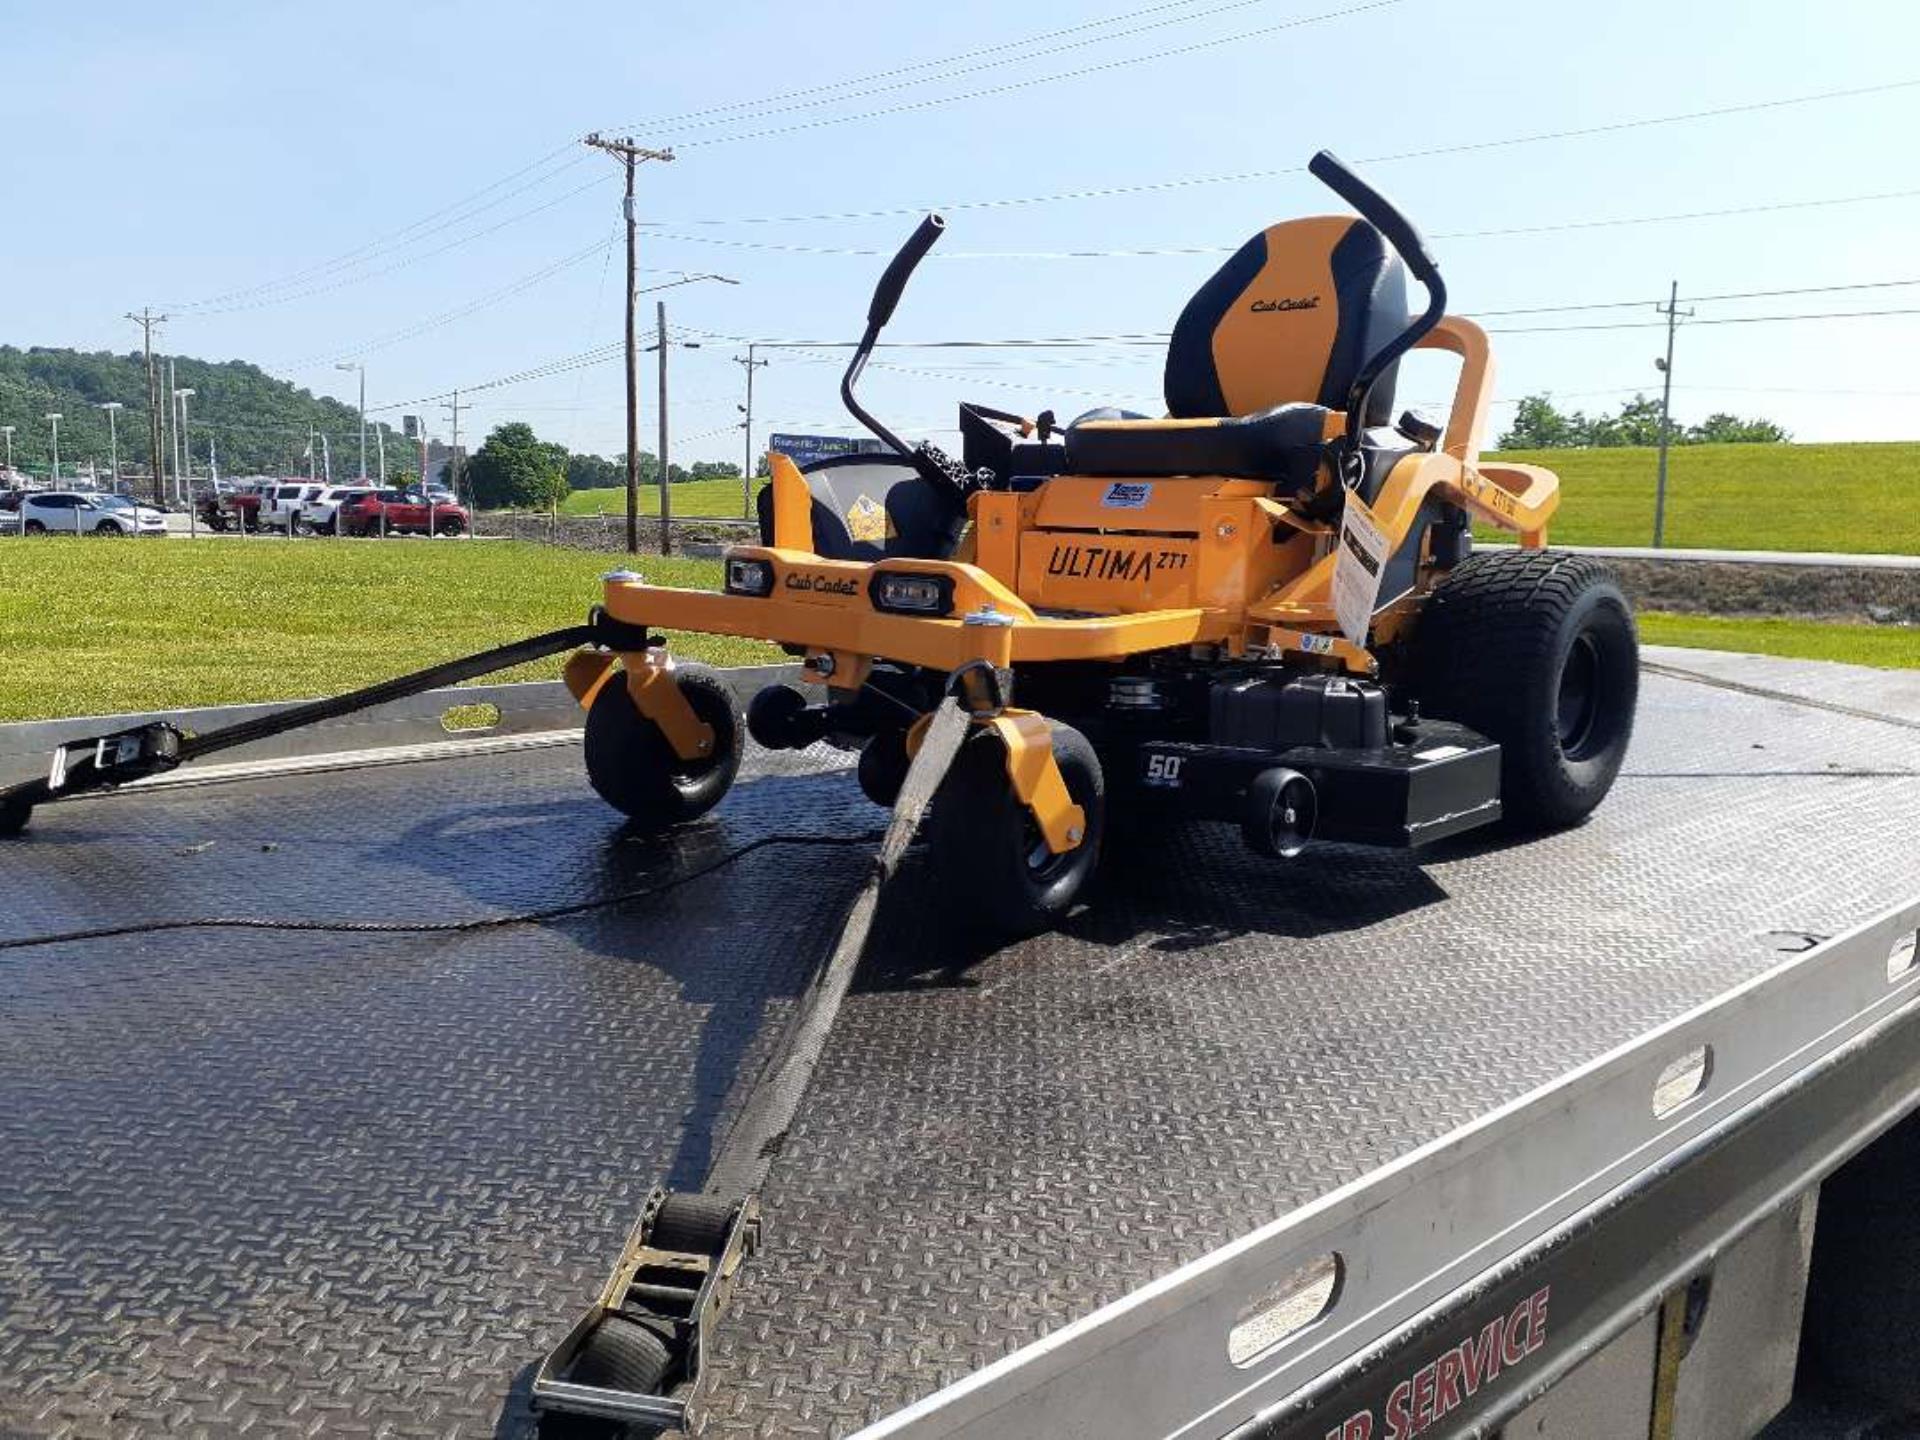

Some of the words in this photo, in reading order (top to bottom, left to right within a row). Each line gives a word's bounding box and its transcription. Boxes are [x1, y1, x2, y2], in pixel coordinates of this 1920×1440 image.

[1251, 299, 1277, 312] Cub
[1278, 296, 1320, 312] Cadet
[1048, 546, 1152, 582] ULTIMA
[785, 572, 812, 590] Cub
[813, 575, 859, 596] Cadet
[1384, 1285, 1550, 1440] SERVICE
